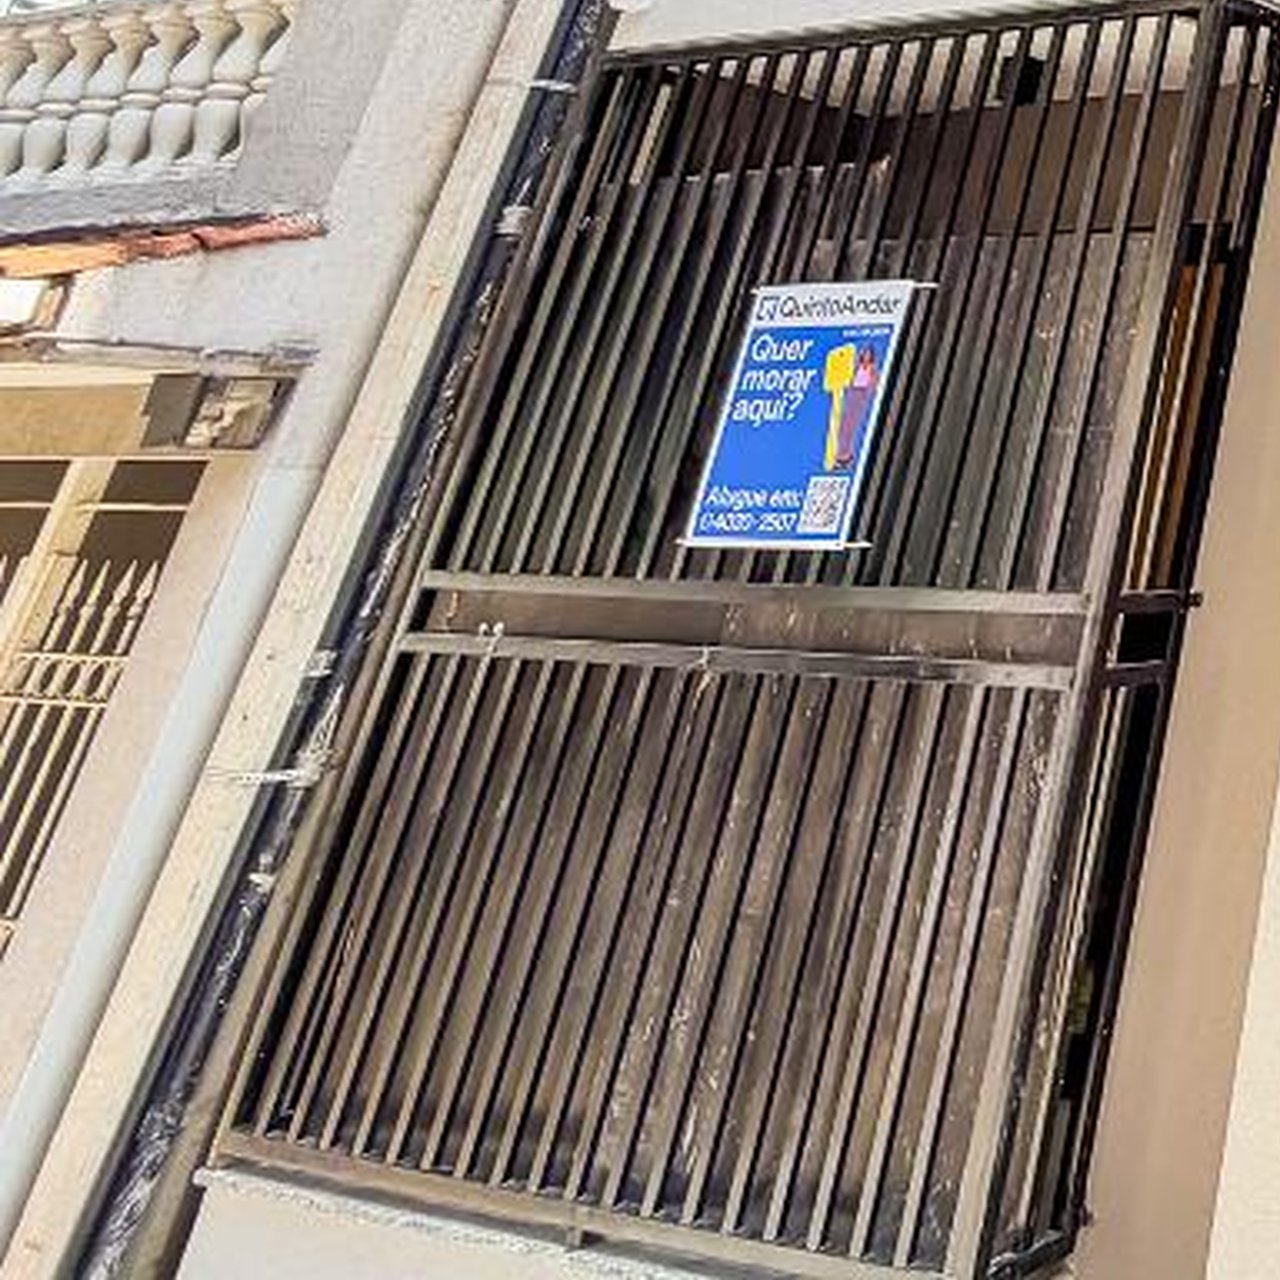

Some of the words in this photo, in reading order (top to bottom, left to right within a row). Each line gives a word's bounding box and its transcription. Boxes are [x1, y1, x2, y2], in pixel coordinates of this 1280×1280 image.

[752, 333, 814, 361] Quer
[741, 368, 817, 391] morar
[731, 392, 804, 428] aqui?
